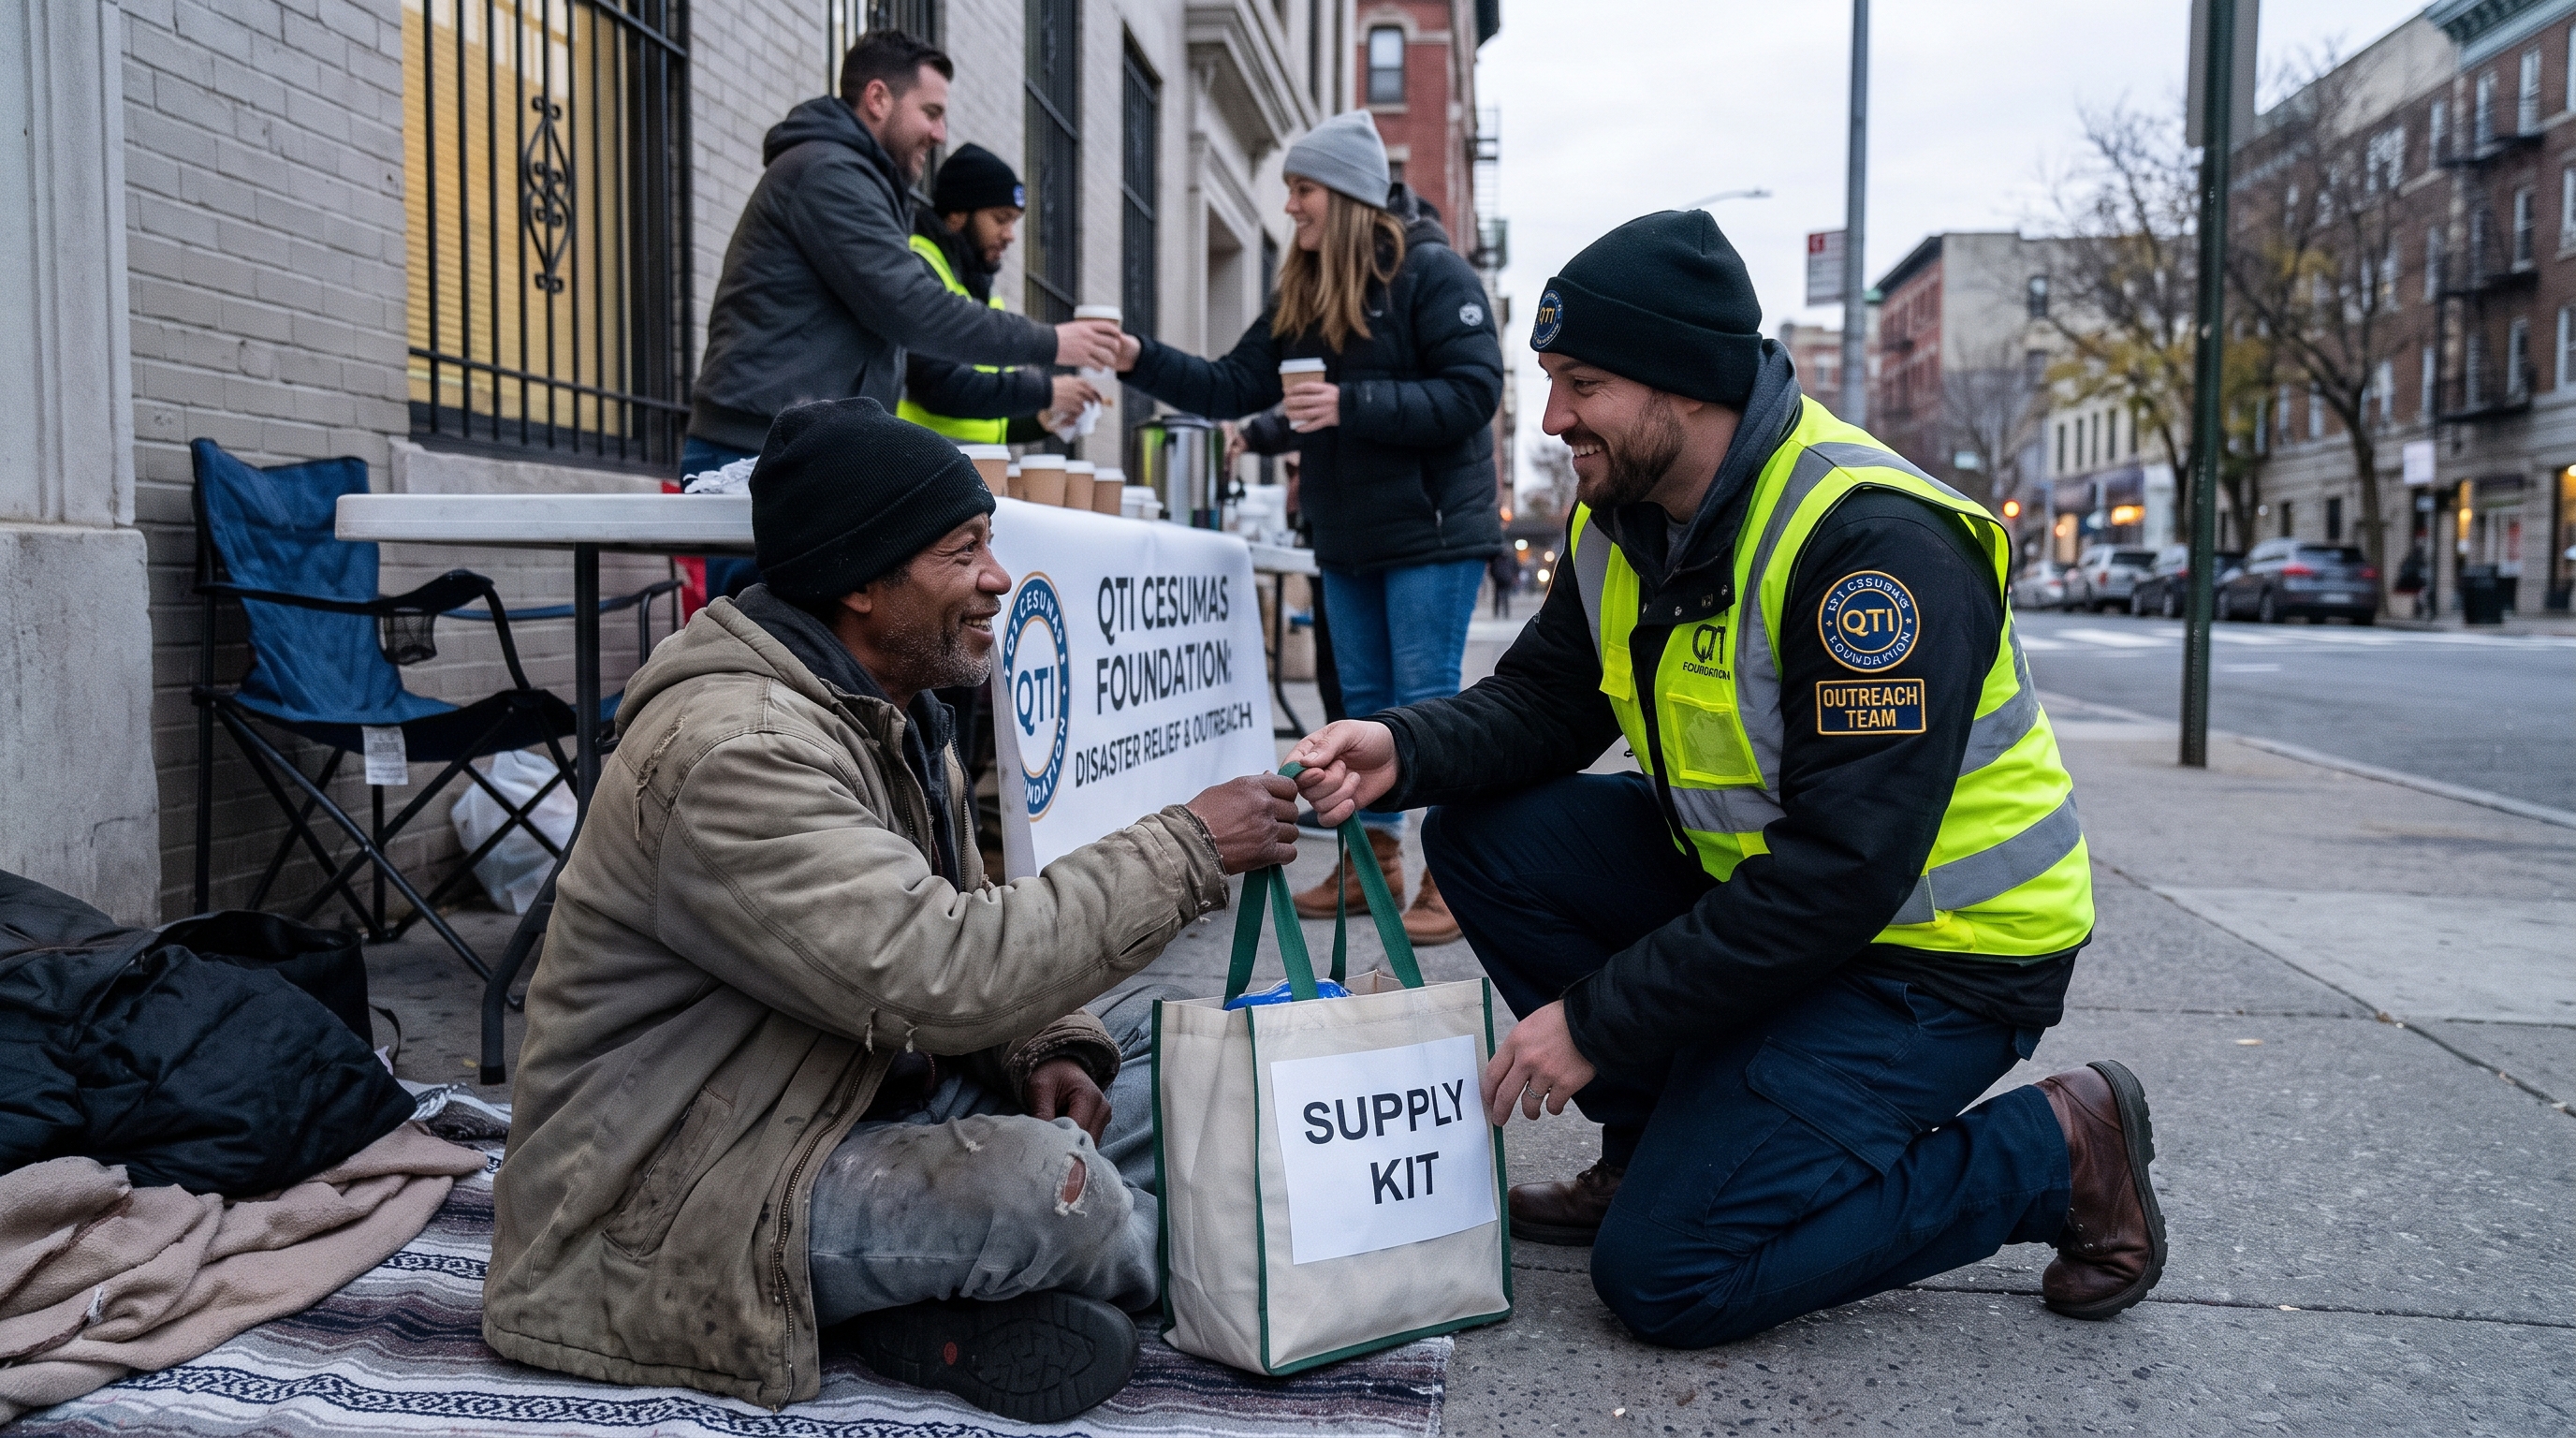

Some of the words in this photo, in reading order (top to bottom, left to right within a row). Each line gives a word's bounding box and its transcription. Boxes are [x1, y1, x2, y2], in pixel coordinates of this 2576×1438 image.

[1098, 577, 1134, 646] QTI
[1142, 575, 1229, 630] CESUMAS
[1842, 609, 1894, 638] QTI
[1016, 666, 1055, 737] QTI
[1097, 639, 1232, 715] FOUNDATION:
[1823, 686, 1918, 708] OUTREACH
[1076, 734, 1141, 788] DISASTER
[1144, 720, 1181, 763] RELIEF
[1184, 717, 1191, 748] &
[1193, 701, 1252, 744] OUTREACH
[1845, 709, 1896, 728] TEAM
[1023, 717, 1065, 804] NDATION
[1303, 1078, 1464, 1145] SUPPLY
[1370, 1151, 1440, 1205] KIT
